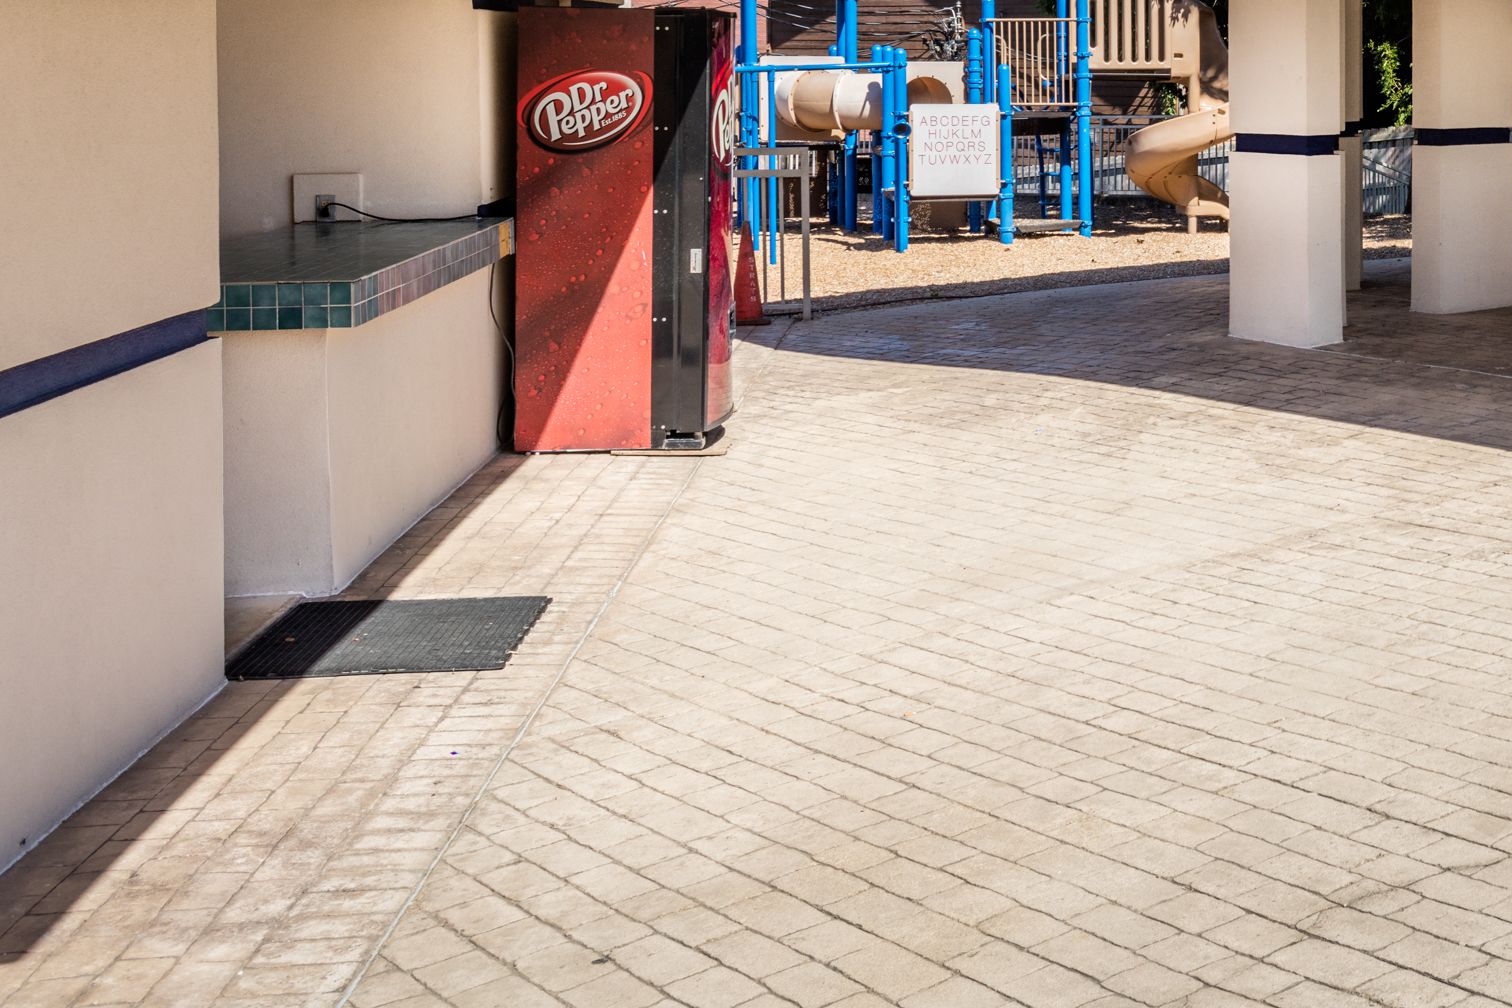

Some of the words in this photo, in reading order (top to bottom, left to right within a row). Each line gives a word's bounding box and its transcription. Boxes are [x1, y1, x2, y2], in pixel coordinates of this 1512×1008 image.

[569, 81, 608, 112] Dr
[534, 88, 634, 142] Pepper
[920, 115, 991, 127] ABCDEFG
[928, 128, 982, 140] HIJKLM
[924, 141, 986, 153] NOPQRS
[919, 153, 992, 166] TUVWXYZ
